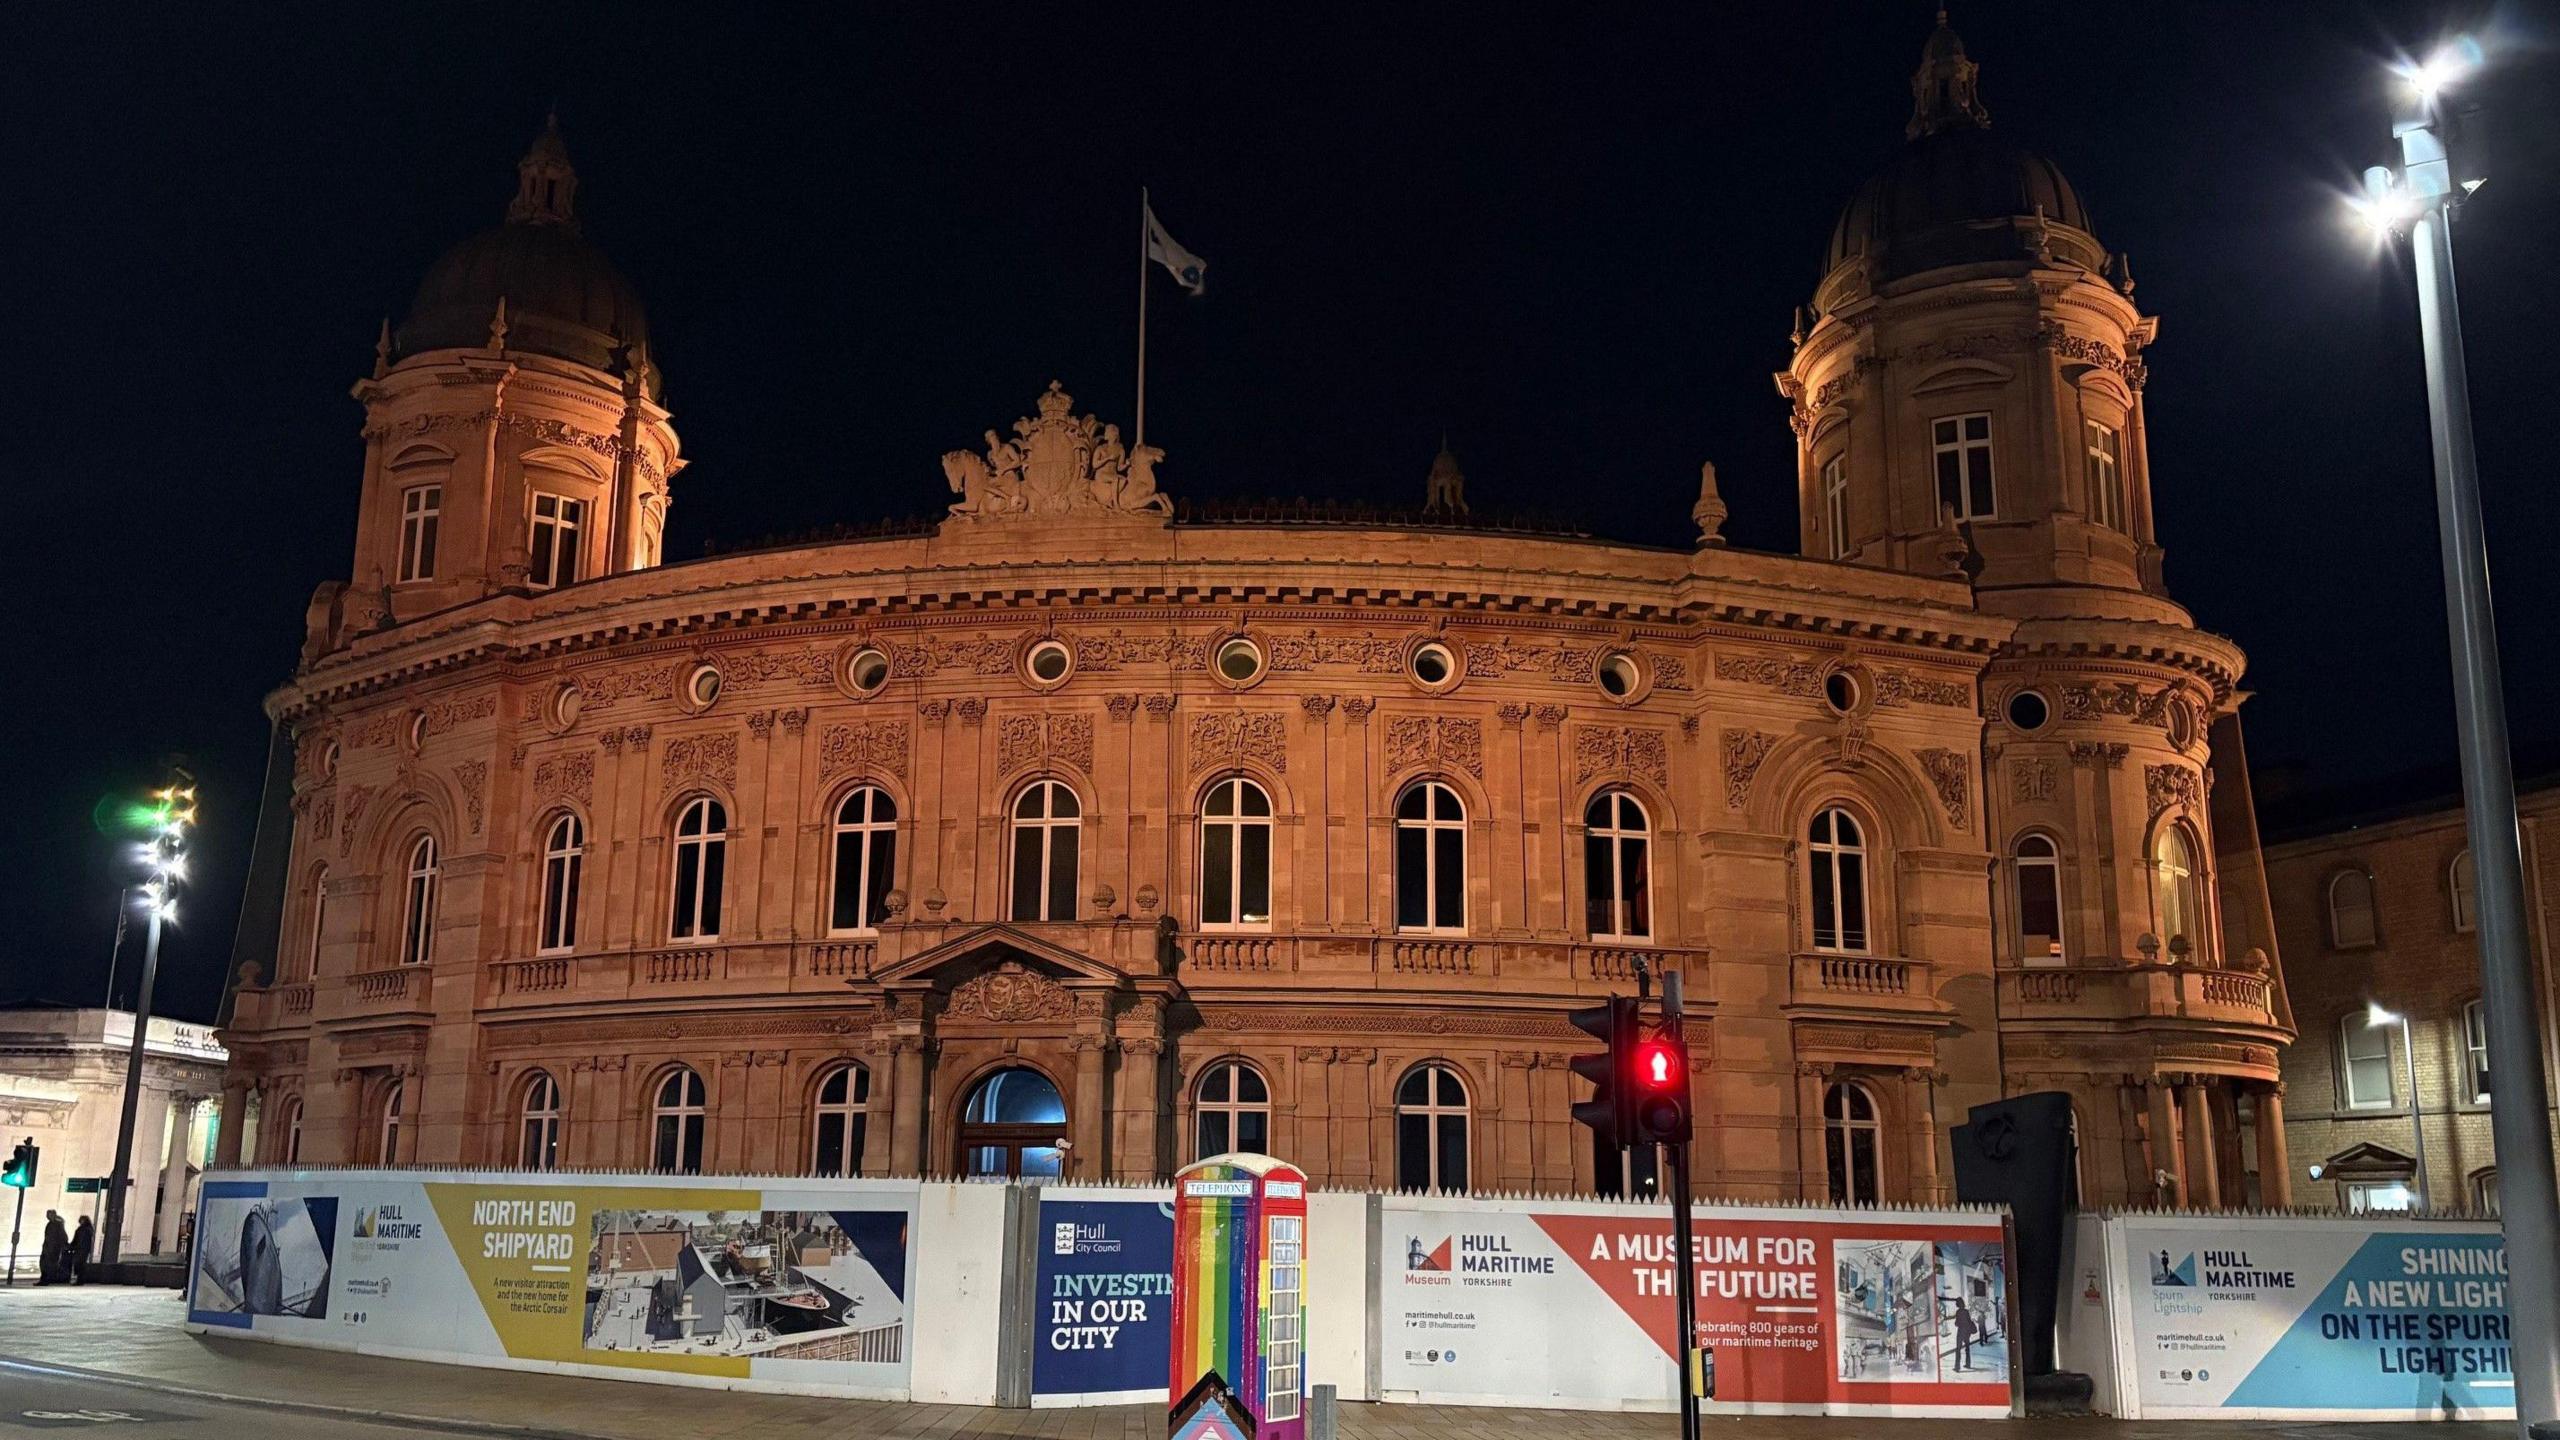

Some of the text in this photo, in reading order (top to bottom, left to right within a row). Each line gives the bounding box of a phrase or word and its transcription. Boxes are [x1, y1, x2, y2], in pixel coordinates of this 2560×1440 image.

[1189, 1183, 1248, 1194] TELEPHONE
[379, 1205, 403, 1220] HULL
[473, 1200, 576, 1226] NORTH END
[377, 1224, 422, 1239] MARITIME
[1076, 1223, 1106, 1239] Hull
[483, 1232, 574, 1260] SHIPYARD
[1076, 1243, 1121, 1254] City Council
[1461, 1235, 1512, 1252] HULL
[1590, 1233, 1817, 1265] A MUSEUM FOR
[1462, 1255, 1554, 1274] MARITIME
[2204, 1251, 2253, 1267] HULL
[493, 1277, 570, 1290] A new visitor attraction
[1405, 1274, 1451, 1285] Museum
[1463, 1278, 1512, 1287] YORKSHIRE
[1632, 1268, 1818, 1299] TH FUTURE
[2206, 1271, 2295, 1288] MARITIME
[497, 1289, 569, 1302] and the new home for
[2153, 1289, 2184, 1303] Spurn
[2208, 1293, 2256, 1301] YORKSHIRE
[2344, 1280, 2507, 1307] A NEW LIGH
[510, 1301, 568, 1314] the Arctic Corsair
[1052, 1300, 1147, 1324] IN OUR
[2154, 1303, 2203, 1317] Lightship
[1405, 1312, 1475, 1320] maritimehull.co.uk
[1695, 1320, 1819, 1336] lebrating 800 years of
[2321, 1313, 2360, 1340] ON
[2366, 1314, 2421, 1340] THE
[1051, 1326, 1119, 1350] CITY
[1702, 1336, 1819, 1351] our maritime heritage
[2157, 1334, 2225, 1342] maritimehull.co.uk
[2380, 1347, 2513, 1373] LIGHTSHI
